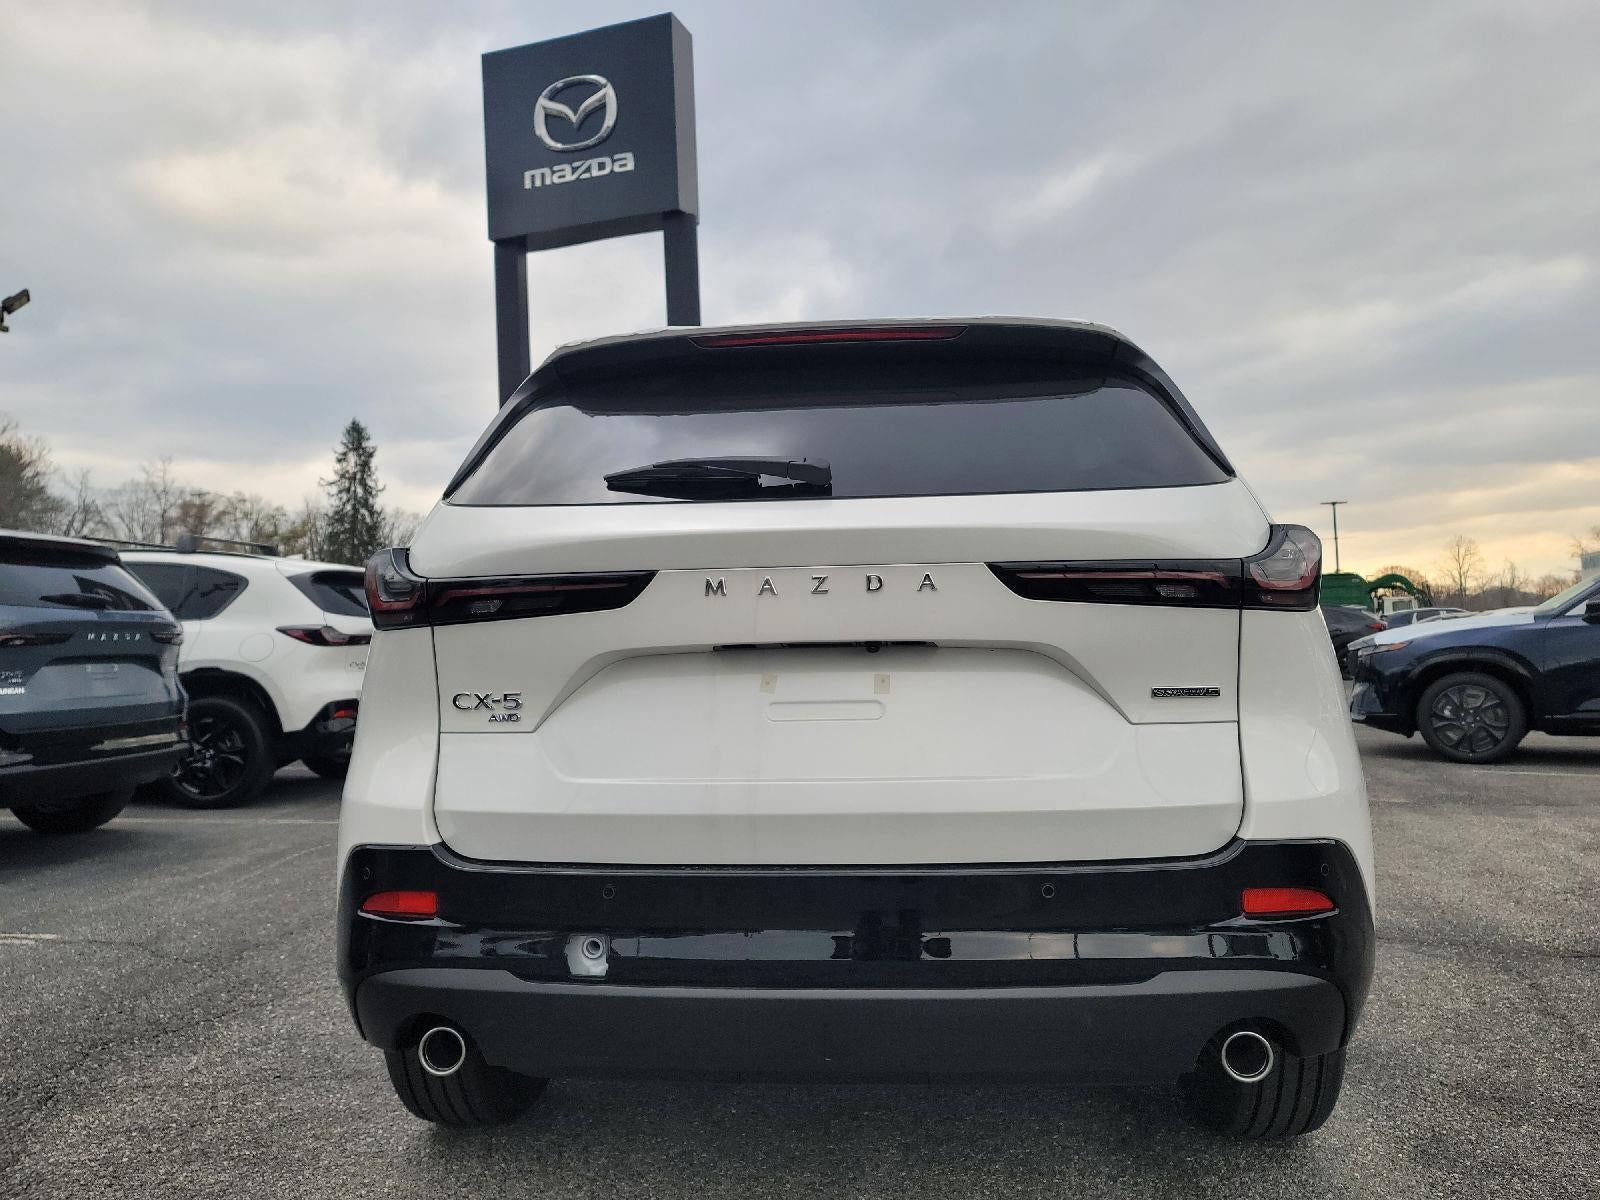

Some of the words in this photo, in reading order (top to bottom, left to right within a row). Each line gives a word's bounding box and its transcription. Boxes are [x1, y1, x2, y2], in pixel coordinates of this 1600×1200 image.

[524, 151, 636, 190] mazda
[704, 572, 938, 597] MAZDA
[452, 691, 523, 710] CX-5
[488, 712, 521, 723] AWD
